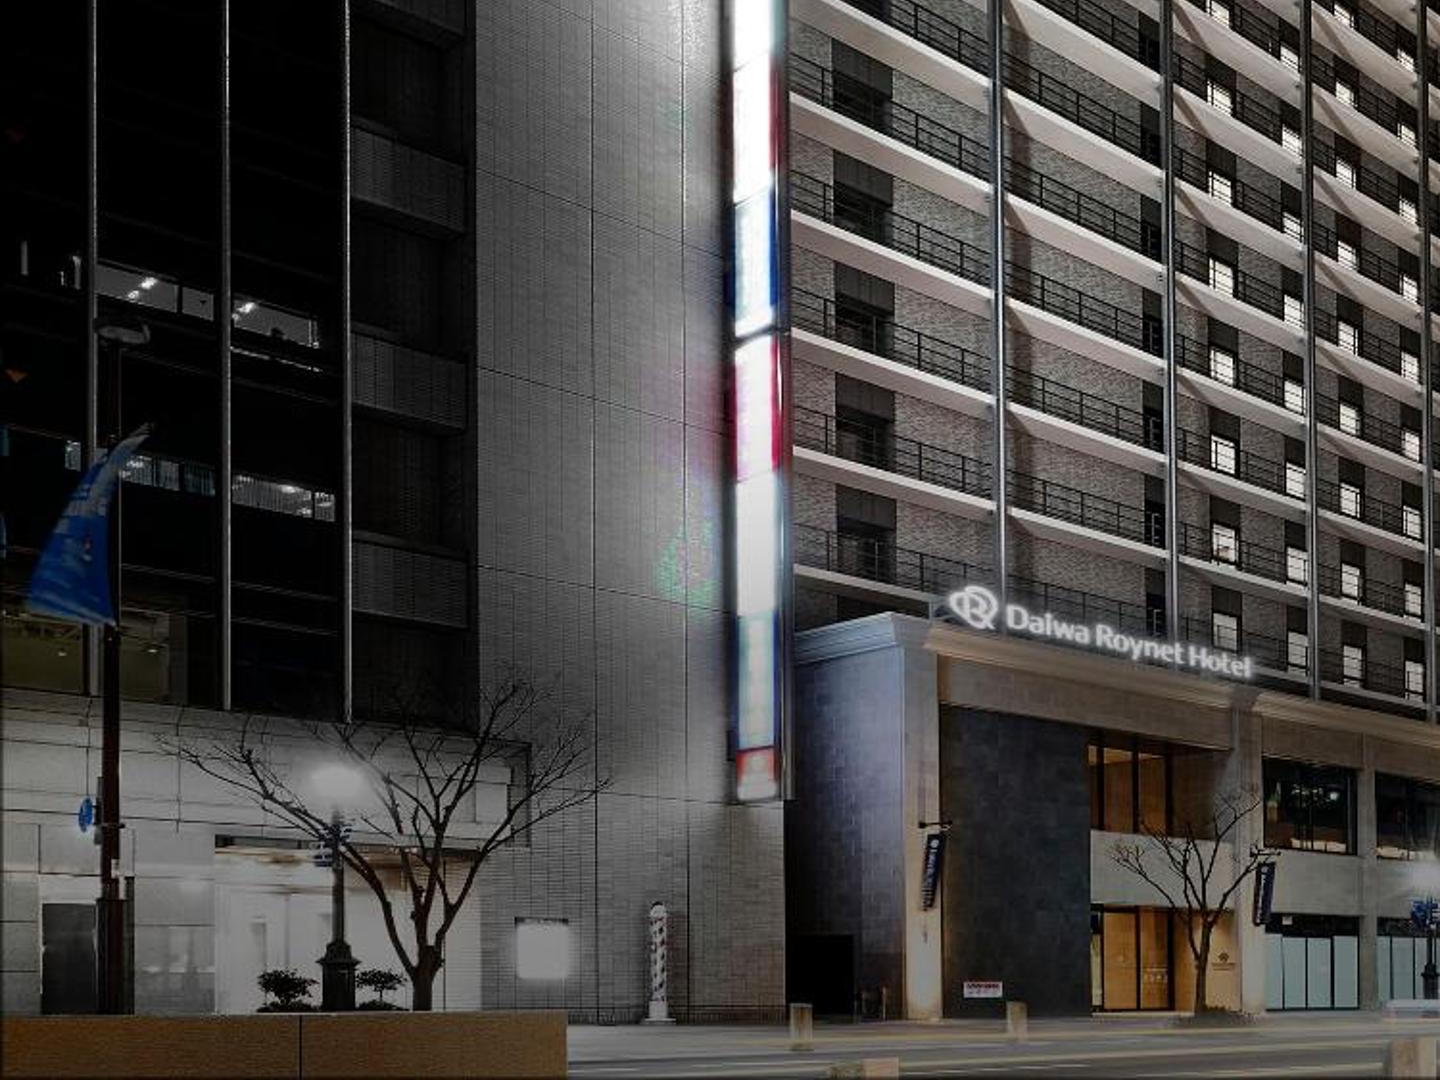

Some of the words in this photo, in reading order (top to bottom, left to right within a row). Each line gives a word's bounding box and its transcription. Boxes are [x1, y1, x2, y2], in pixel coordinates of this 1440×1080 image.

[1005, 604, 1091, 645] Daiwa
[1095, 624, 1185, 666] Roynet
[1188, 646, 1252, 678] Hotel
